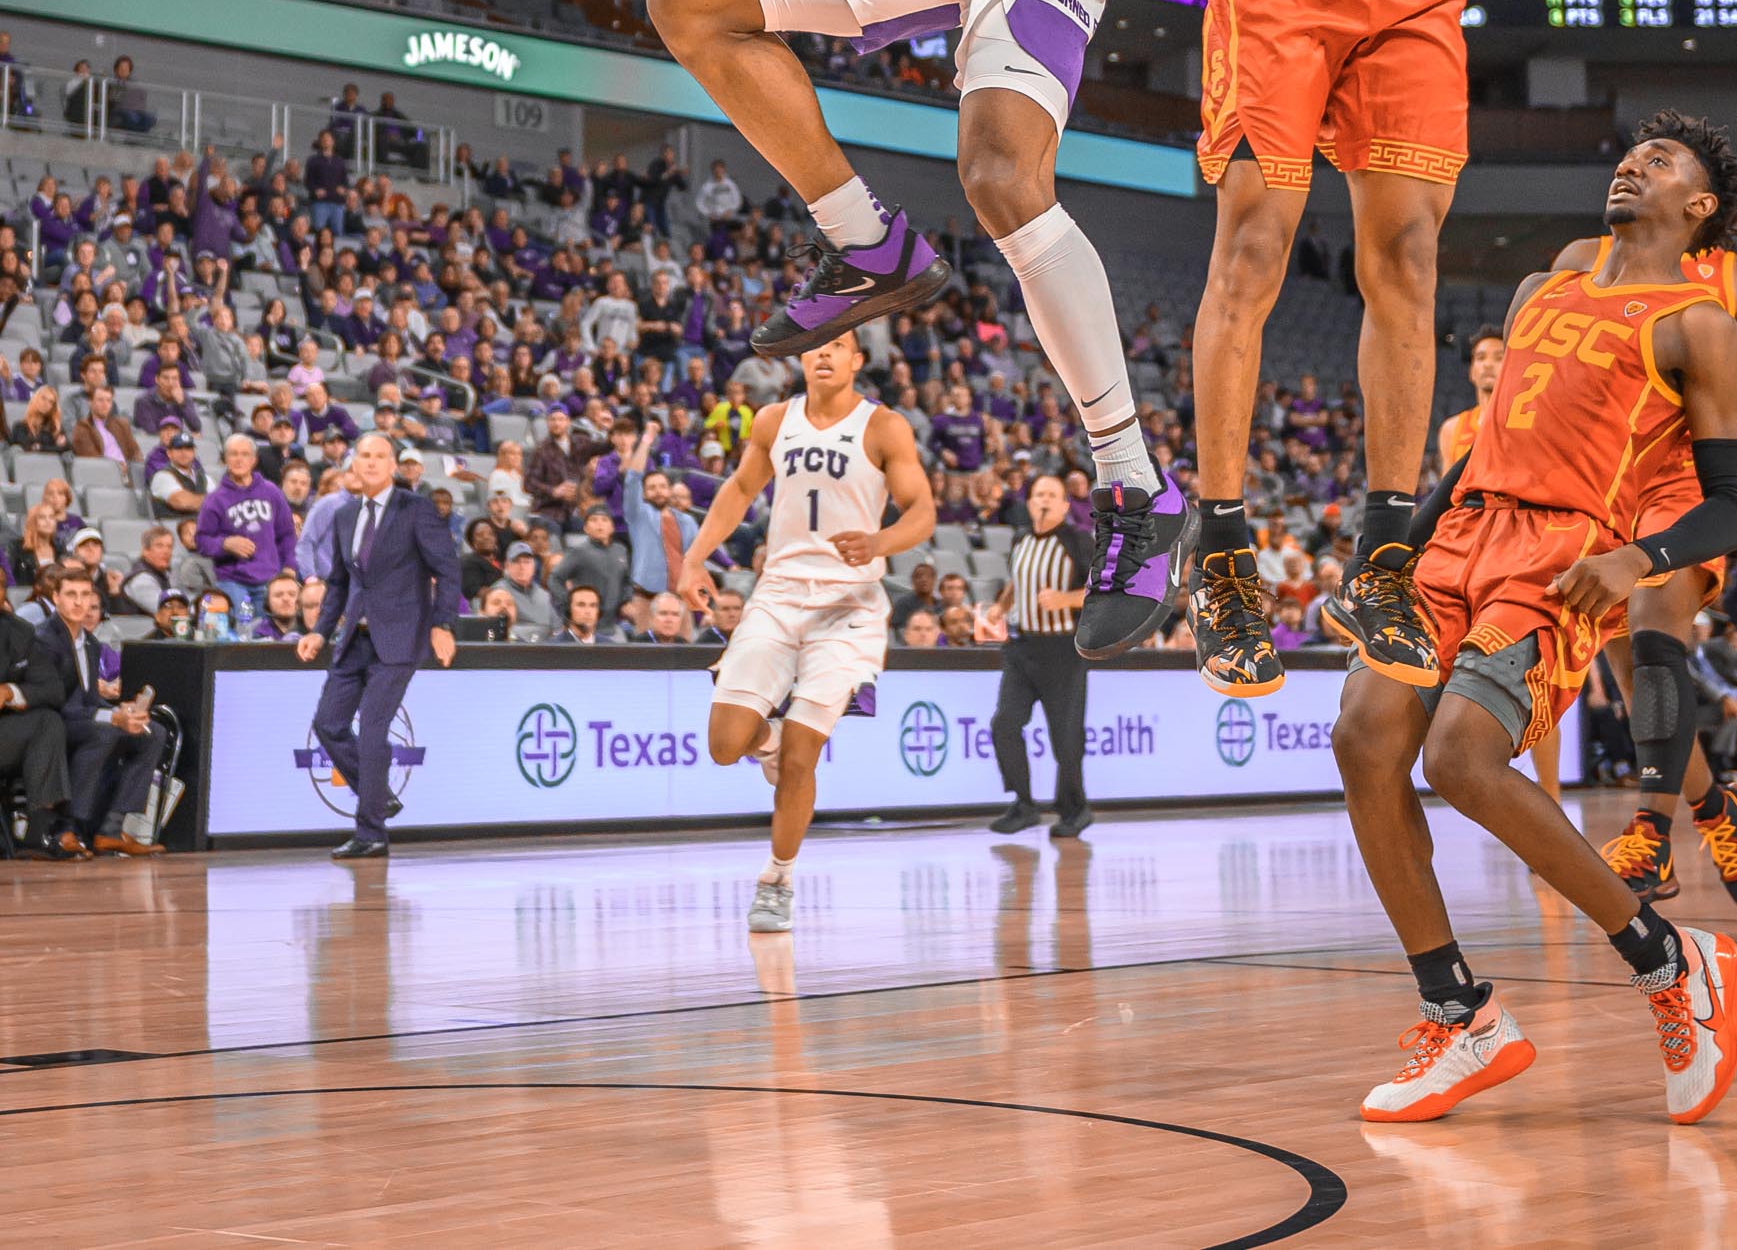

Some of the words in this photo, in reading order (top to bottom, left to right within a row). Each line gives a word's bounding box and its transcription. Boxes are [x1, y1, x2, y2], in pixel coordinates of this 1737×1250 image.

[1565, 8, 1603, 27] PTS
[1636, 8, 1671, 27] FLS
[404, 31, 518, 82] JAMESON
[503, 100, 543, 128] 109
[1508, 306, 1635, 370] USC
[1505, 362, 1555, 430] 2
[784, 446, 850, 481] TCU
[227, 499, 272, 529] TCU
[807, 489, 819, 532] 1
[588, 720, 699, 768] Texas
[957, 717, 1045, 759] Tes
[1085, 714, 1154, 756] ealth
